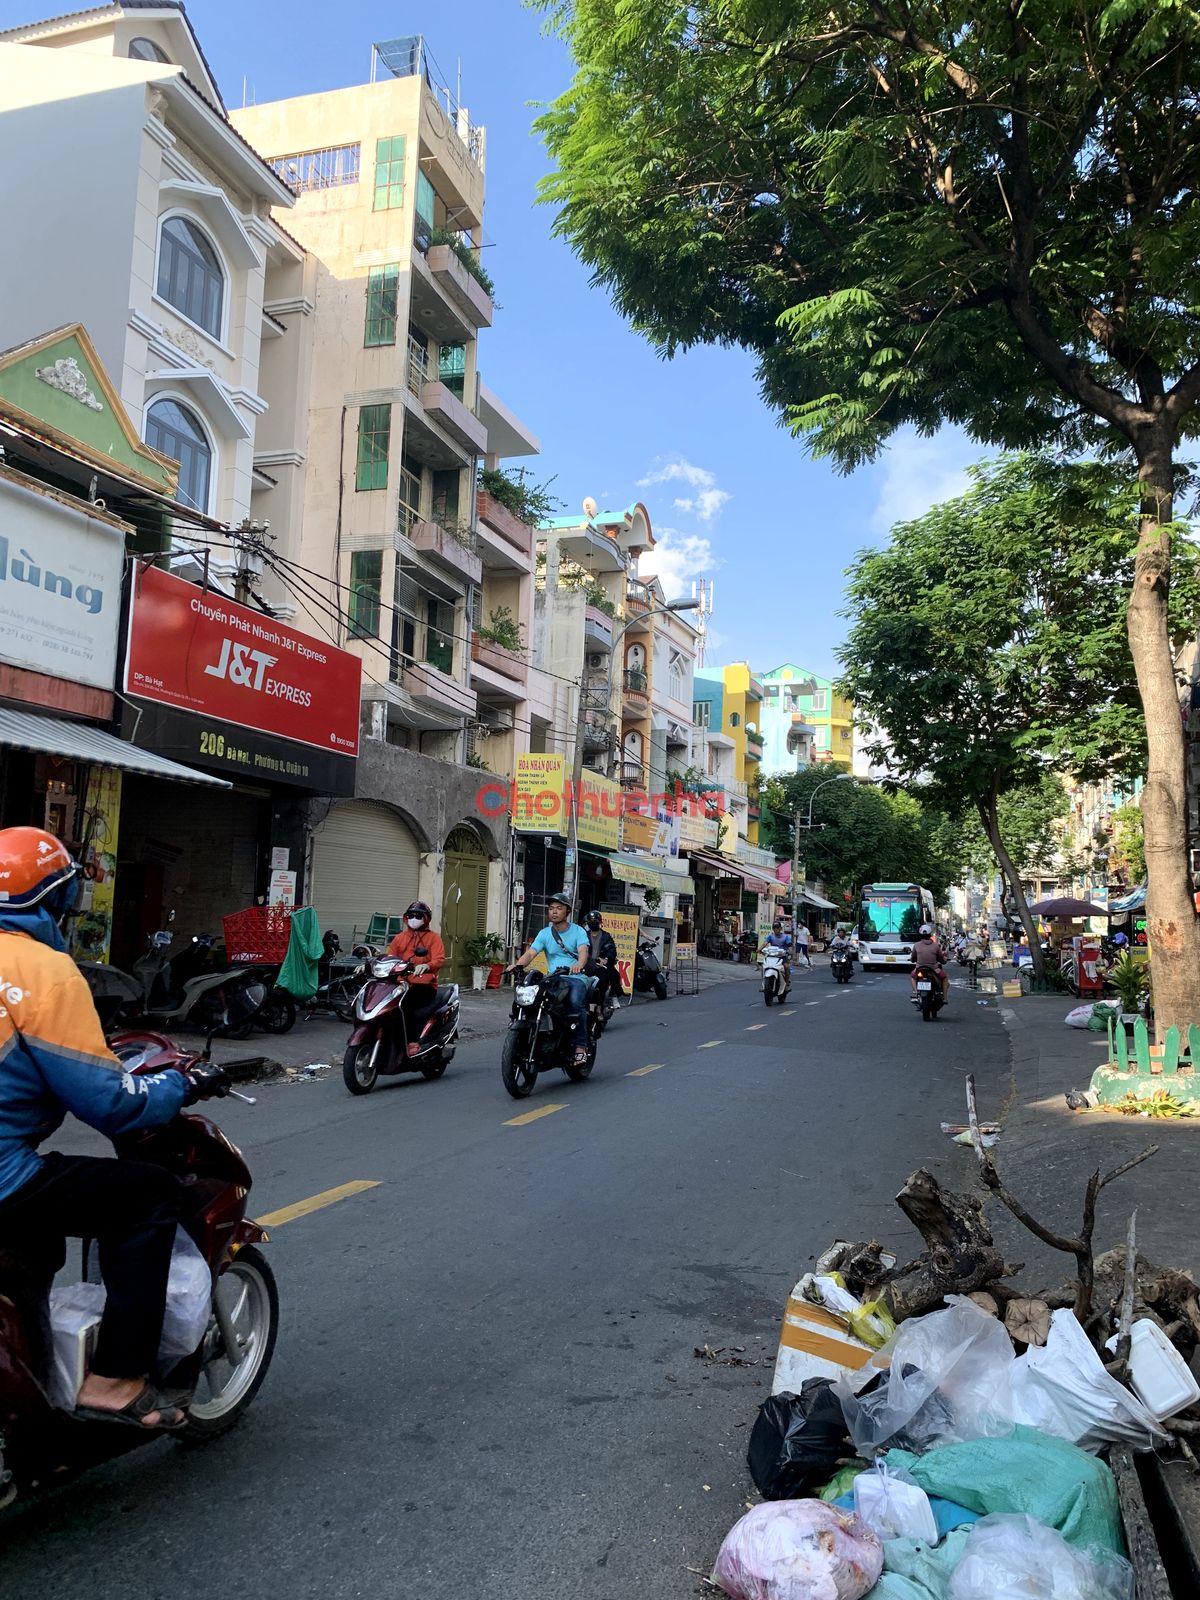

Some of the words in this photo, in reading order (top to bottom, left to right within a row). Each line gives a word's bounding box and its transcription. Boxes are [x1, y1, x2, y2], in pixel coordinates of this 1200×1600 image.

[190, 598, 228, 624] Chuyển
[229, 614, 251, 633] Phát
[252, 625, 280, 645] Nhanh
[281, 636, 297, 652] J&T
[297, 643, 327, 665] Express
[204, 637, 279, 692] J&T
[265, 678, 312, 708] EXPRESS
[199, 731, 225, 757] 206
